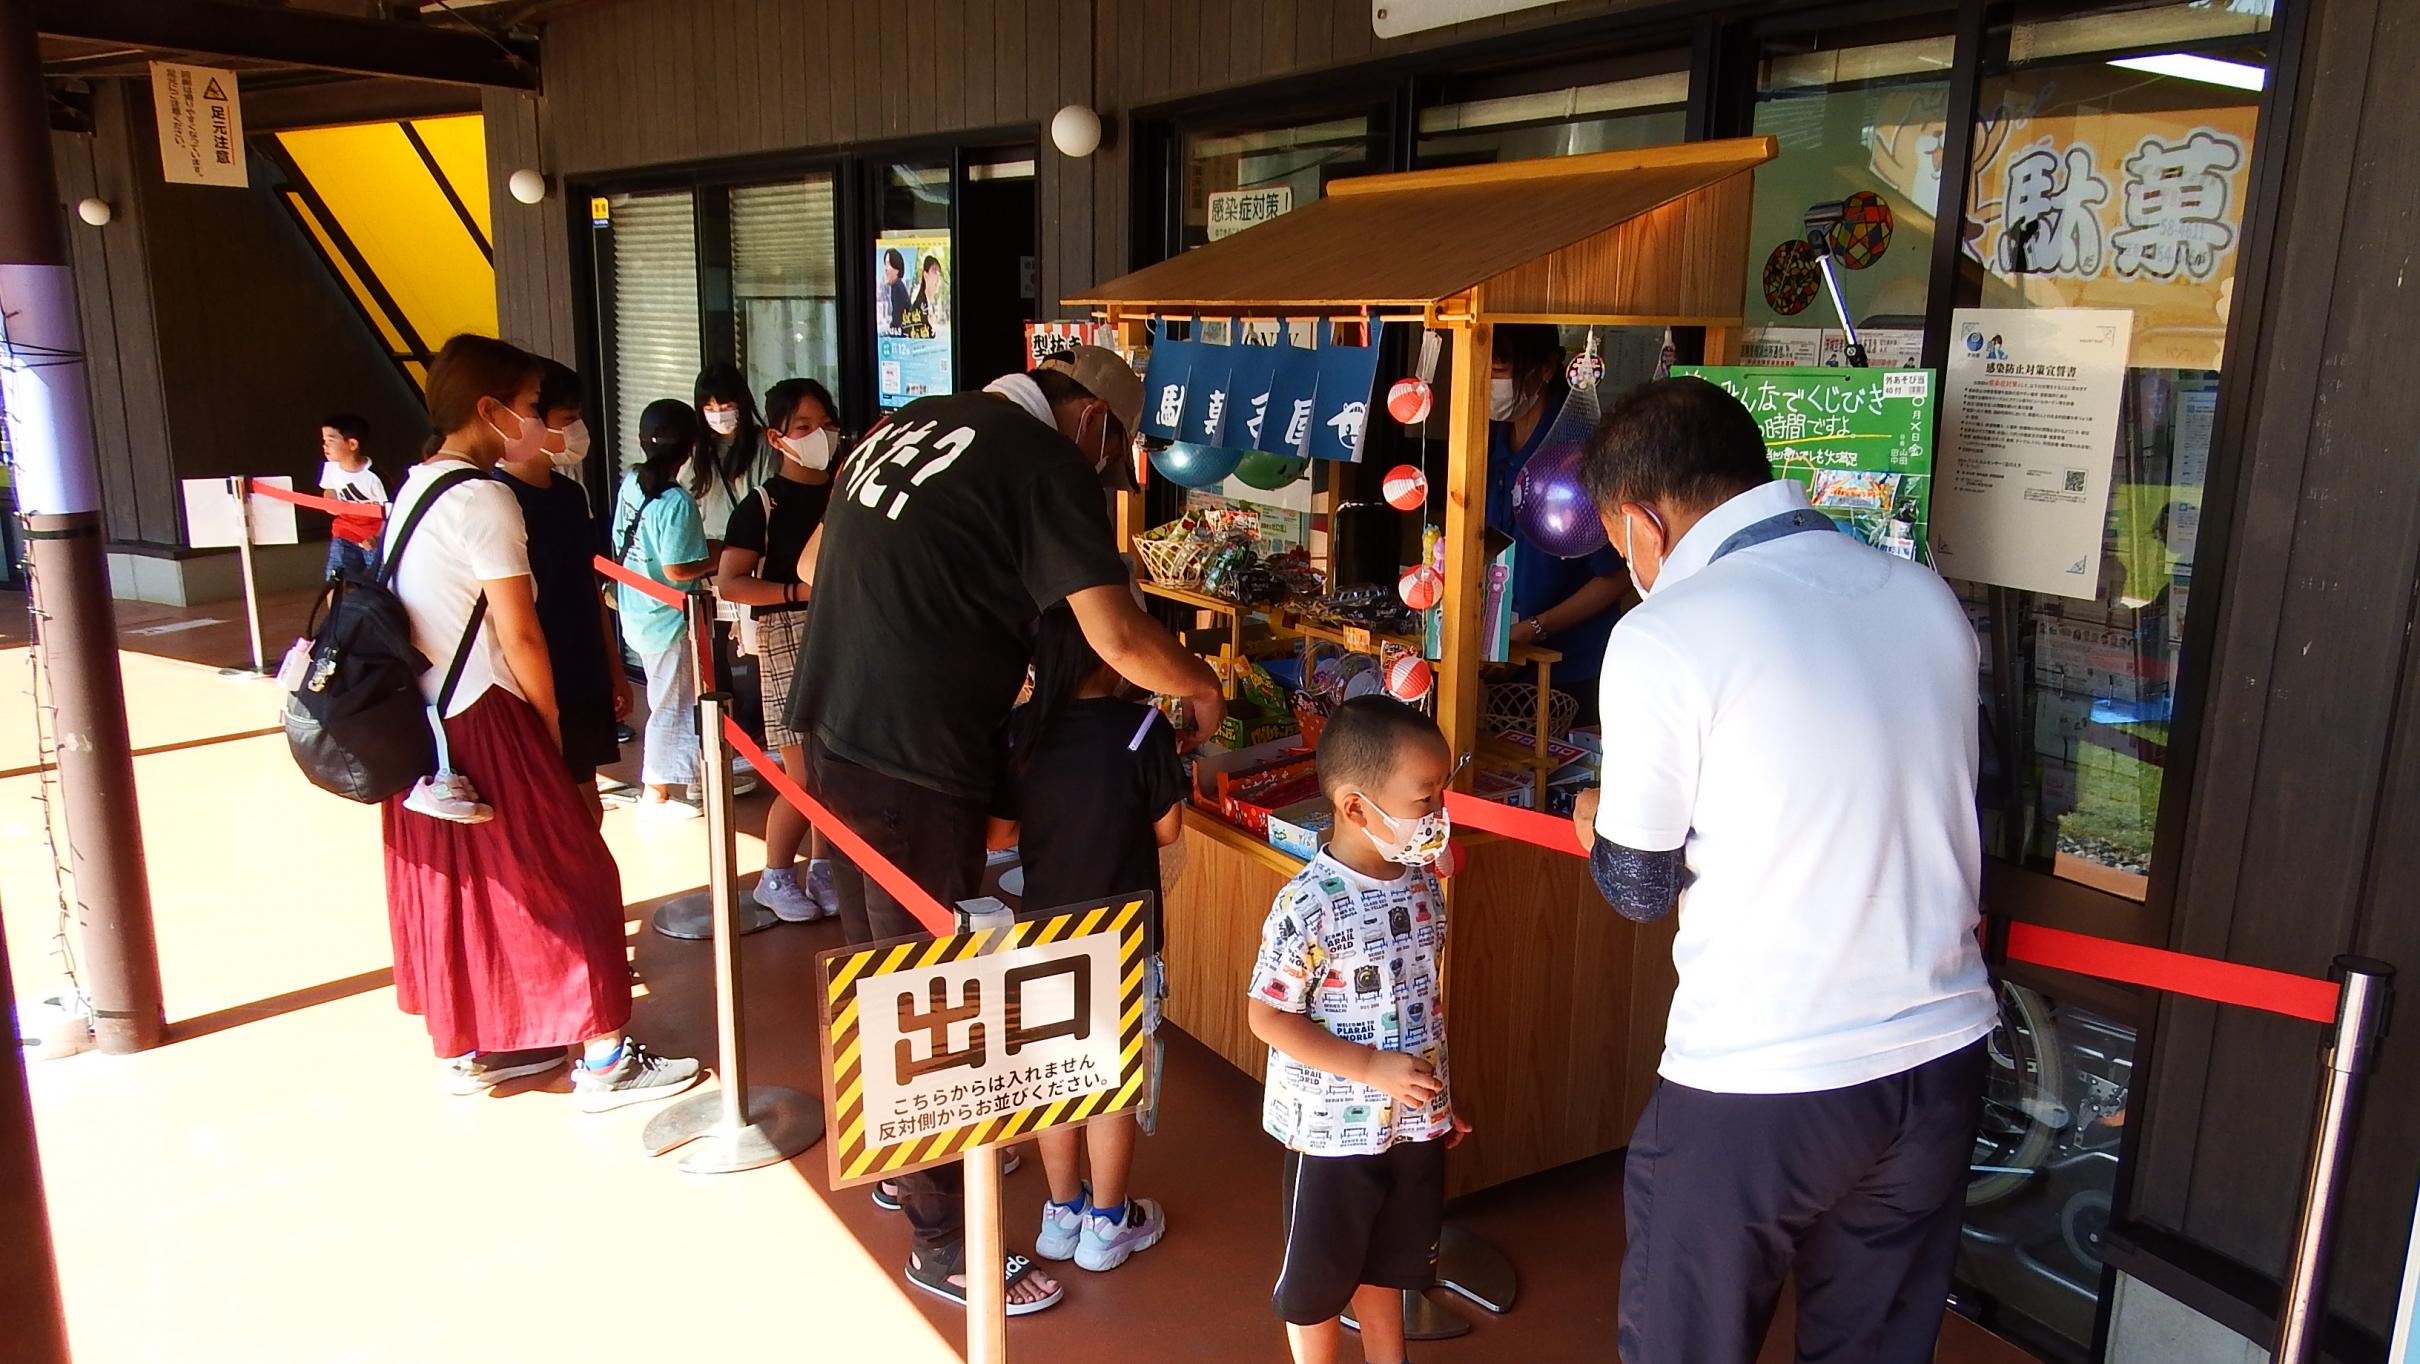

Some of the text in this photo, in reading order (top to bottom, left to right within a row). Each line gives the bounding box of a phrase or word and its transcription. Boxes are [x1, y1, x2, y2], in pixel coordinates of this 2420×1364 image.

[211, 105, 231, 164] 足元注意
[1985, 362, 2077, 378] 感染防止対策宣誓書
[1326, 932, 1356, 948] ARAIL
[1329, 941, 1354, 953] ORLD
[894, 953, 1092, 1086] 出口
[1337, 1024, 1376, 1036] PLARAIL
[1339, 1032, 1374, 1042] WORLD
[1299, 1068, 1322, 1080] RAIL
[1299, 1076, 1320, 1086] ORLD
[893, 1053, 1096, 1116] こちらからは入れません
[877, 1071, 1109, 1142] 反対側からお並びください。
